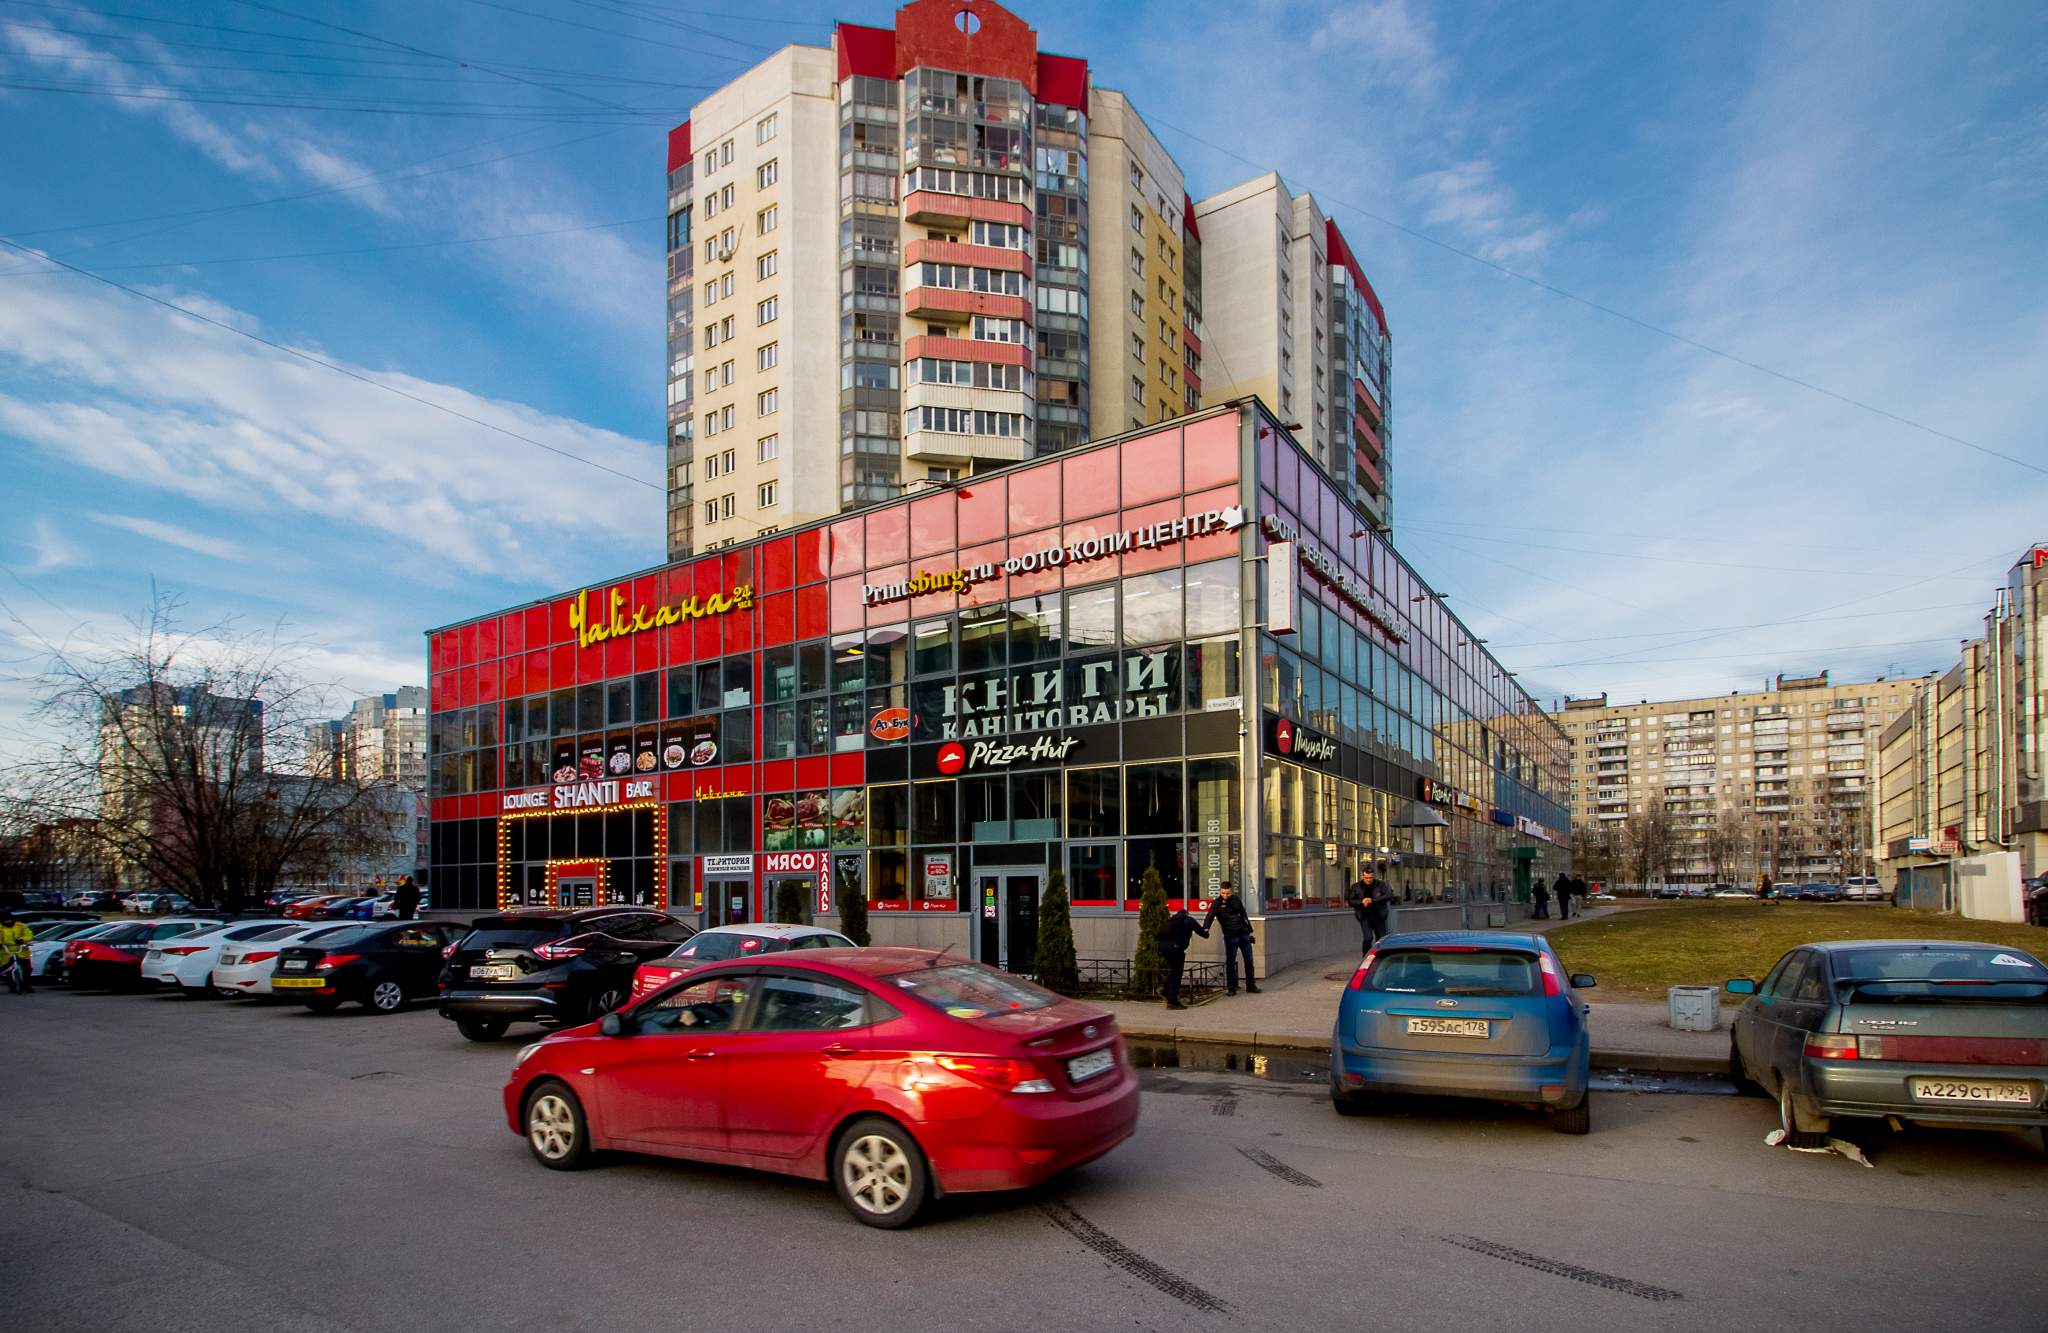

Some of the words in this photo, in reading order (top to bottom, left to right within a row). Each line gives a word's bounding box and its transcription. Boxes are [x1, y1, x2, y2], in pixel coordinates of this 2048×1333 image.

[862, 562, 995, 605] Printsburg.ru
[1004, 546, 1064, 575] ФОТО
[1070, 530, 1132, 561] КОПИ
[1138, 510, 1221, 548] ЦЕНТР
[569, 588, 733, 648] Чайхана
[942, 651, 1168, 717] КНИГИ
[968, 740, 1028, 768] Pizza
[1030, 736, 1079, 761] Hut
[1294, 727, 1321, 758] Пицца
[1319, 736, 1336, 760] Хат
[503, 791, 543, 809] LOUNGE
[554, 780, 618, 808] SHANTI
[626, 781, 649, 798] BAR
[707, 856, 750, 866] ТЕРИТОРИЯ
[767, 853, 815, 871] МЯСО
[821, 853, 829, 911] ХАЛЯЛЬ
[1412, 1020, 1462, 1033] Т595АС
[1922, 1083, 1993, 1099] А229СТ
